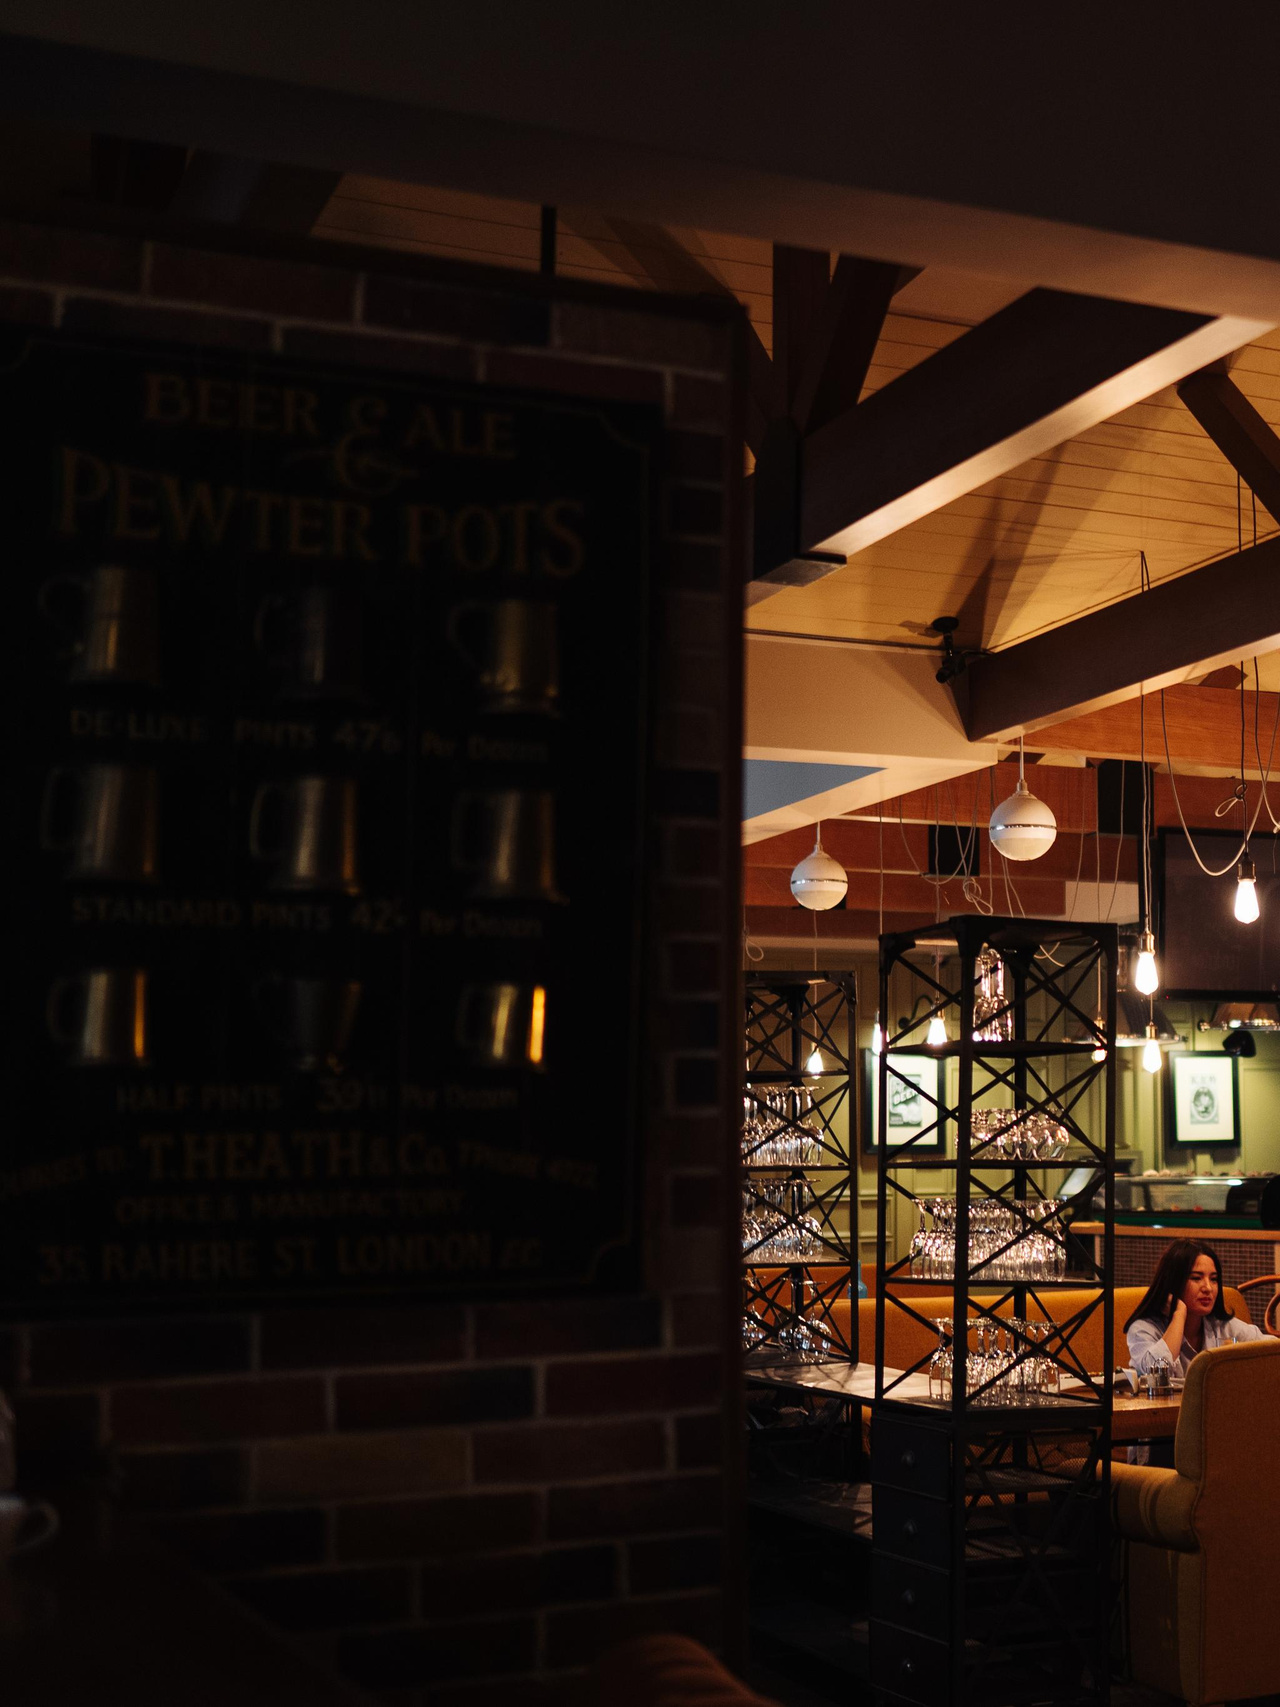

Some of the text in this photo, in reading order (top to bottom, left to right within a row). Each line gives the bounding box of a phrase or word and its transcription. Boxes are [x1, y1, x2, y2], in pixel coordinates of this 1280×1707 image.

[142, 370, 320, 437] BEER
[402, 404, 518, 460] ALE
[52, 444, 588, 579] PEWTER POTS
[336, 1231, 491, 1276] LONDON
